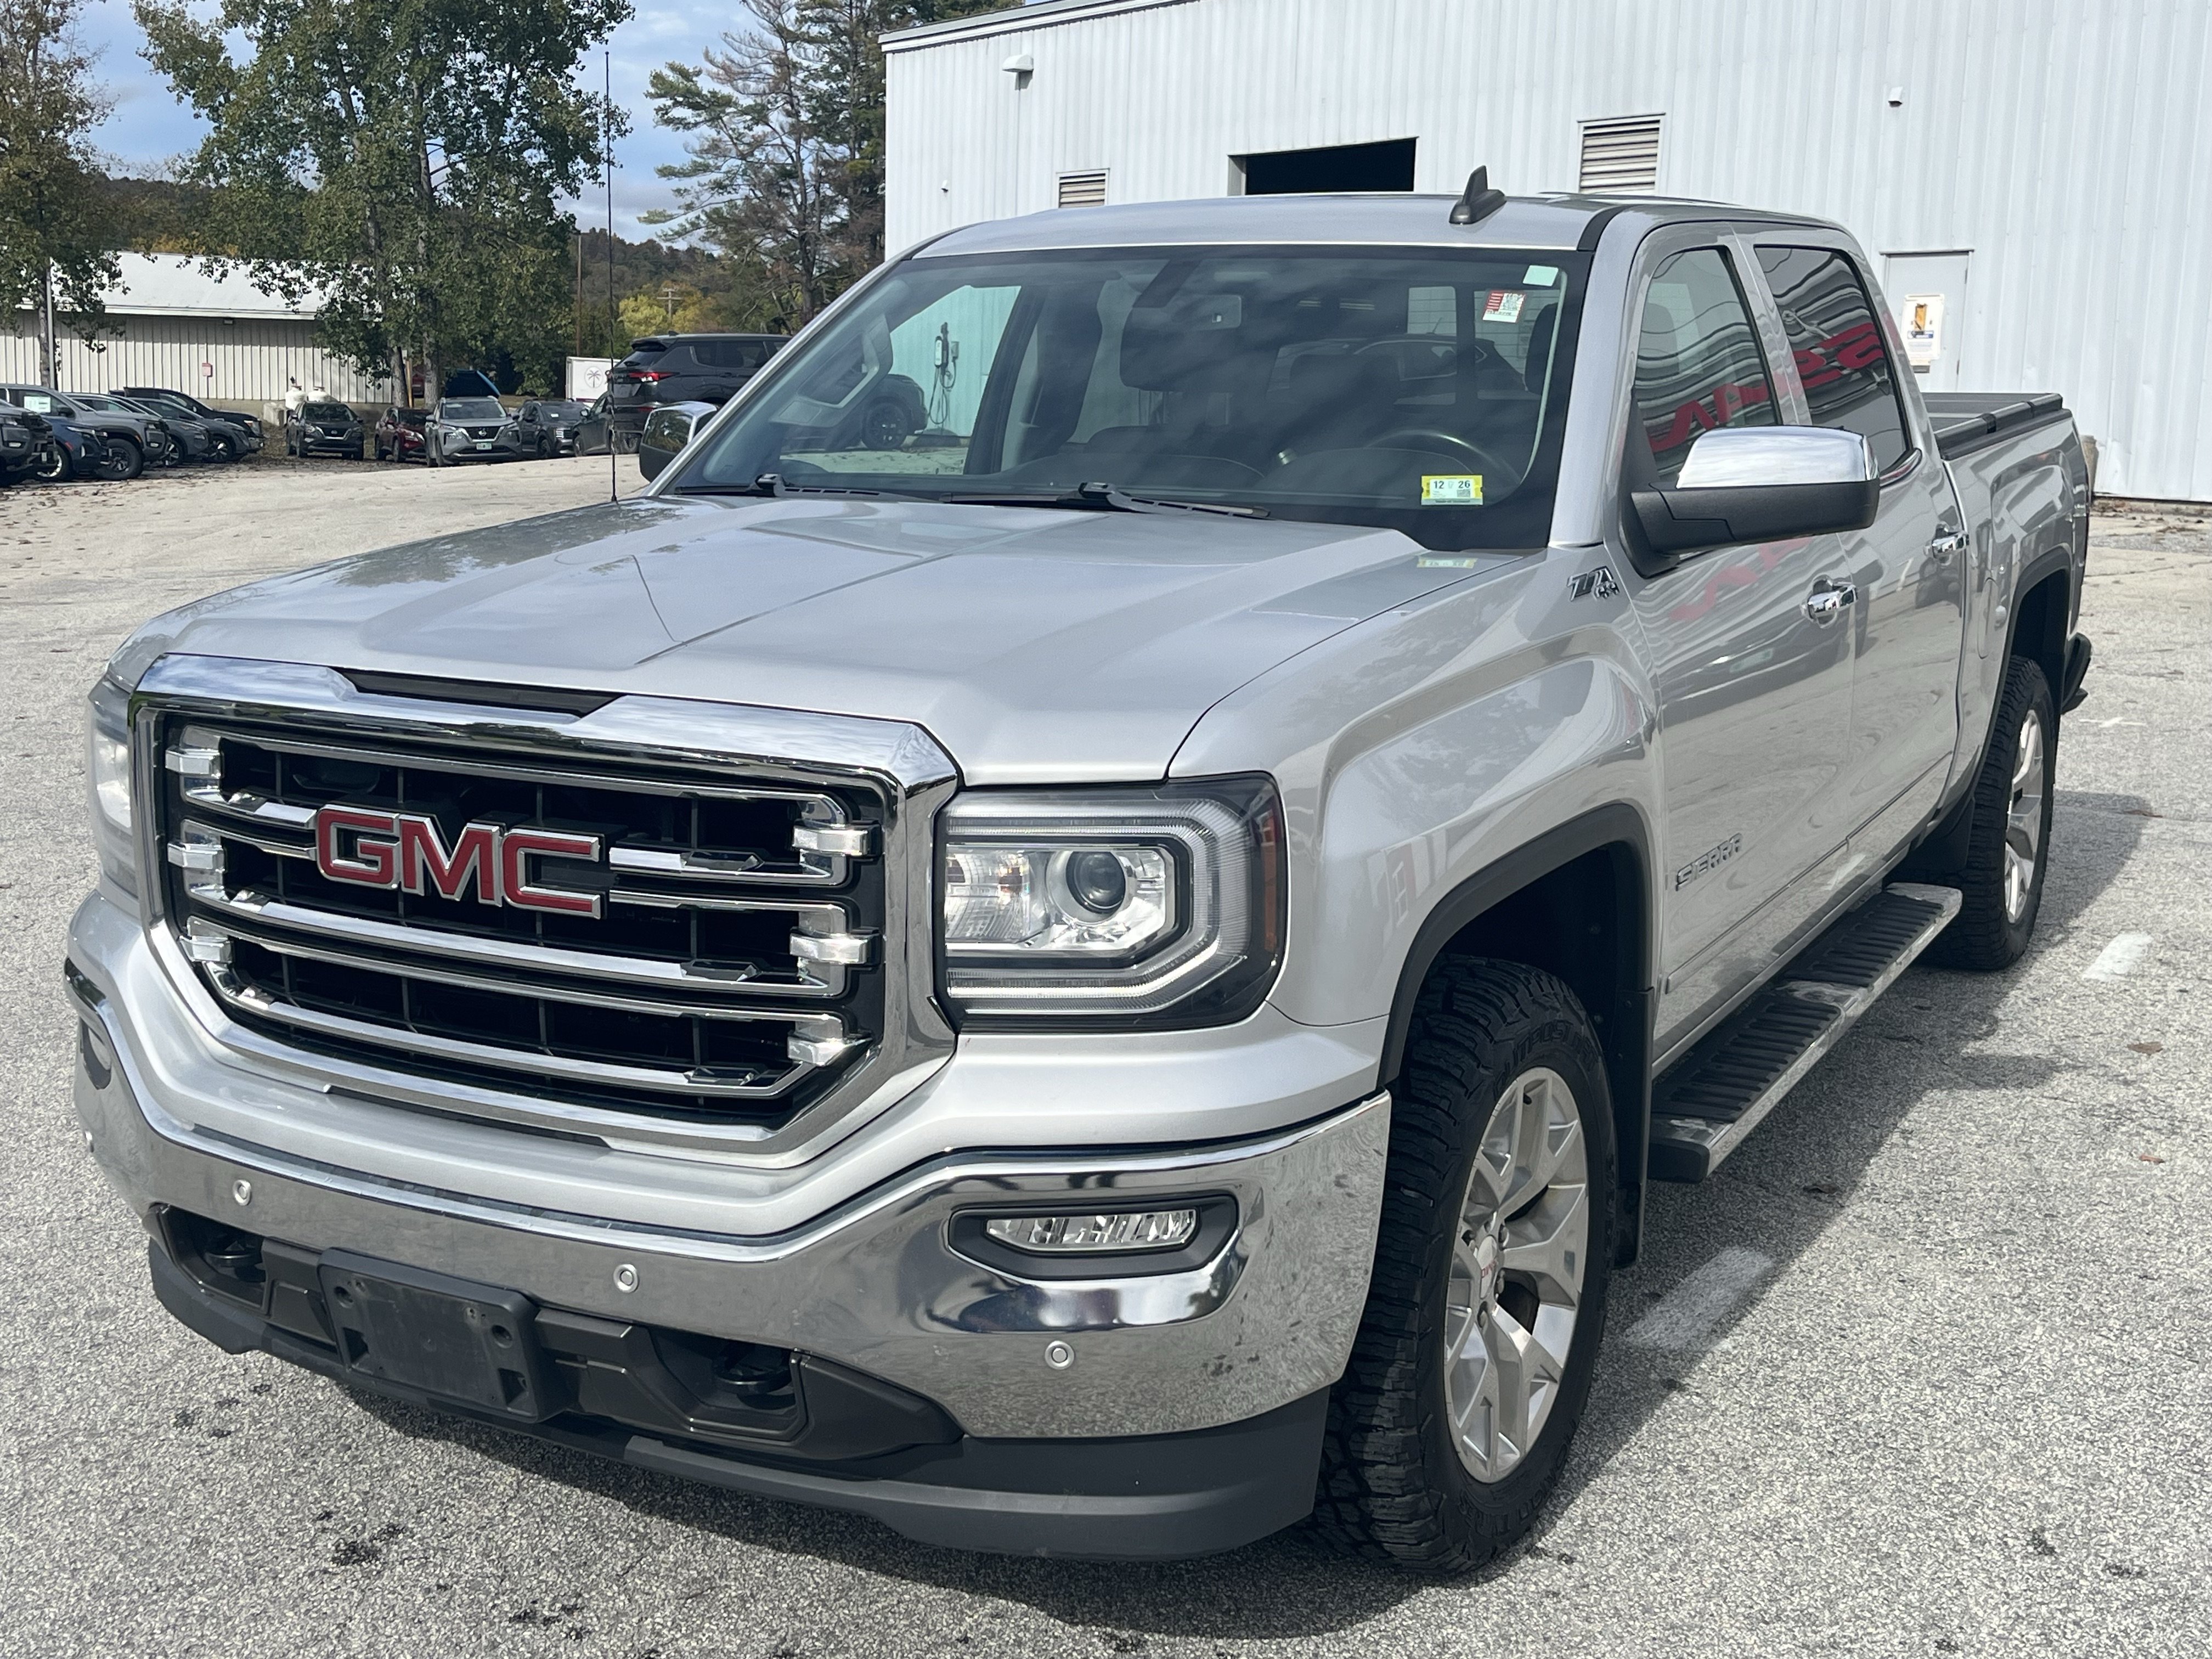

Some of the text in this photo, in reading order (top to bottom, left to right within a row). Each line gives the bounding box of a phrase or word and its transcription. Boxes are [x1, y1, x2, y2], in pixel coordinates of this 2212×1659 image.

[1433, 480, 1471, 489] 12 26
[317, 804, 601, 919] GMC
[1675, 832, 1743, 891] SIERRA
